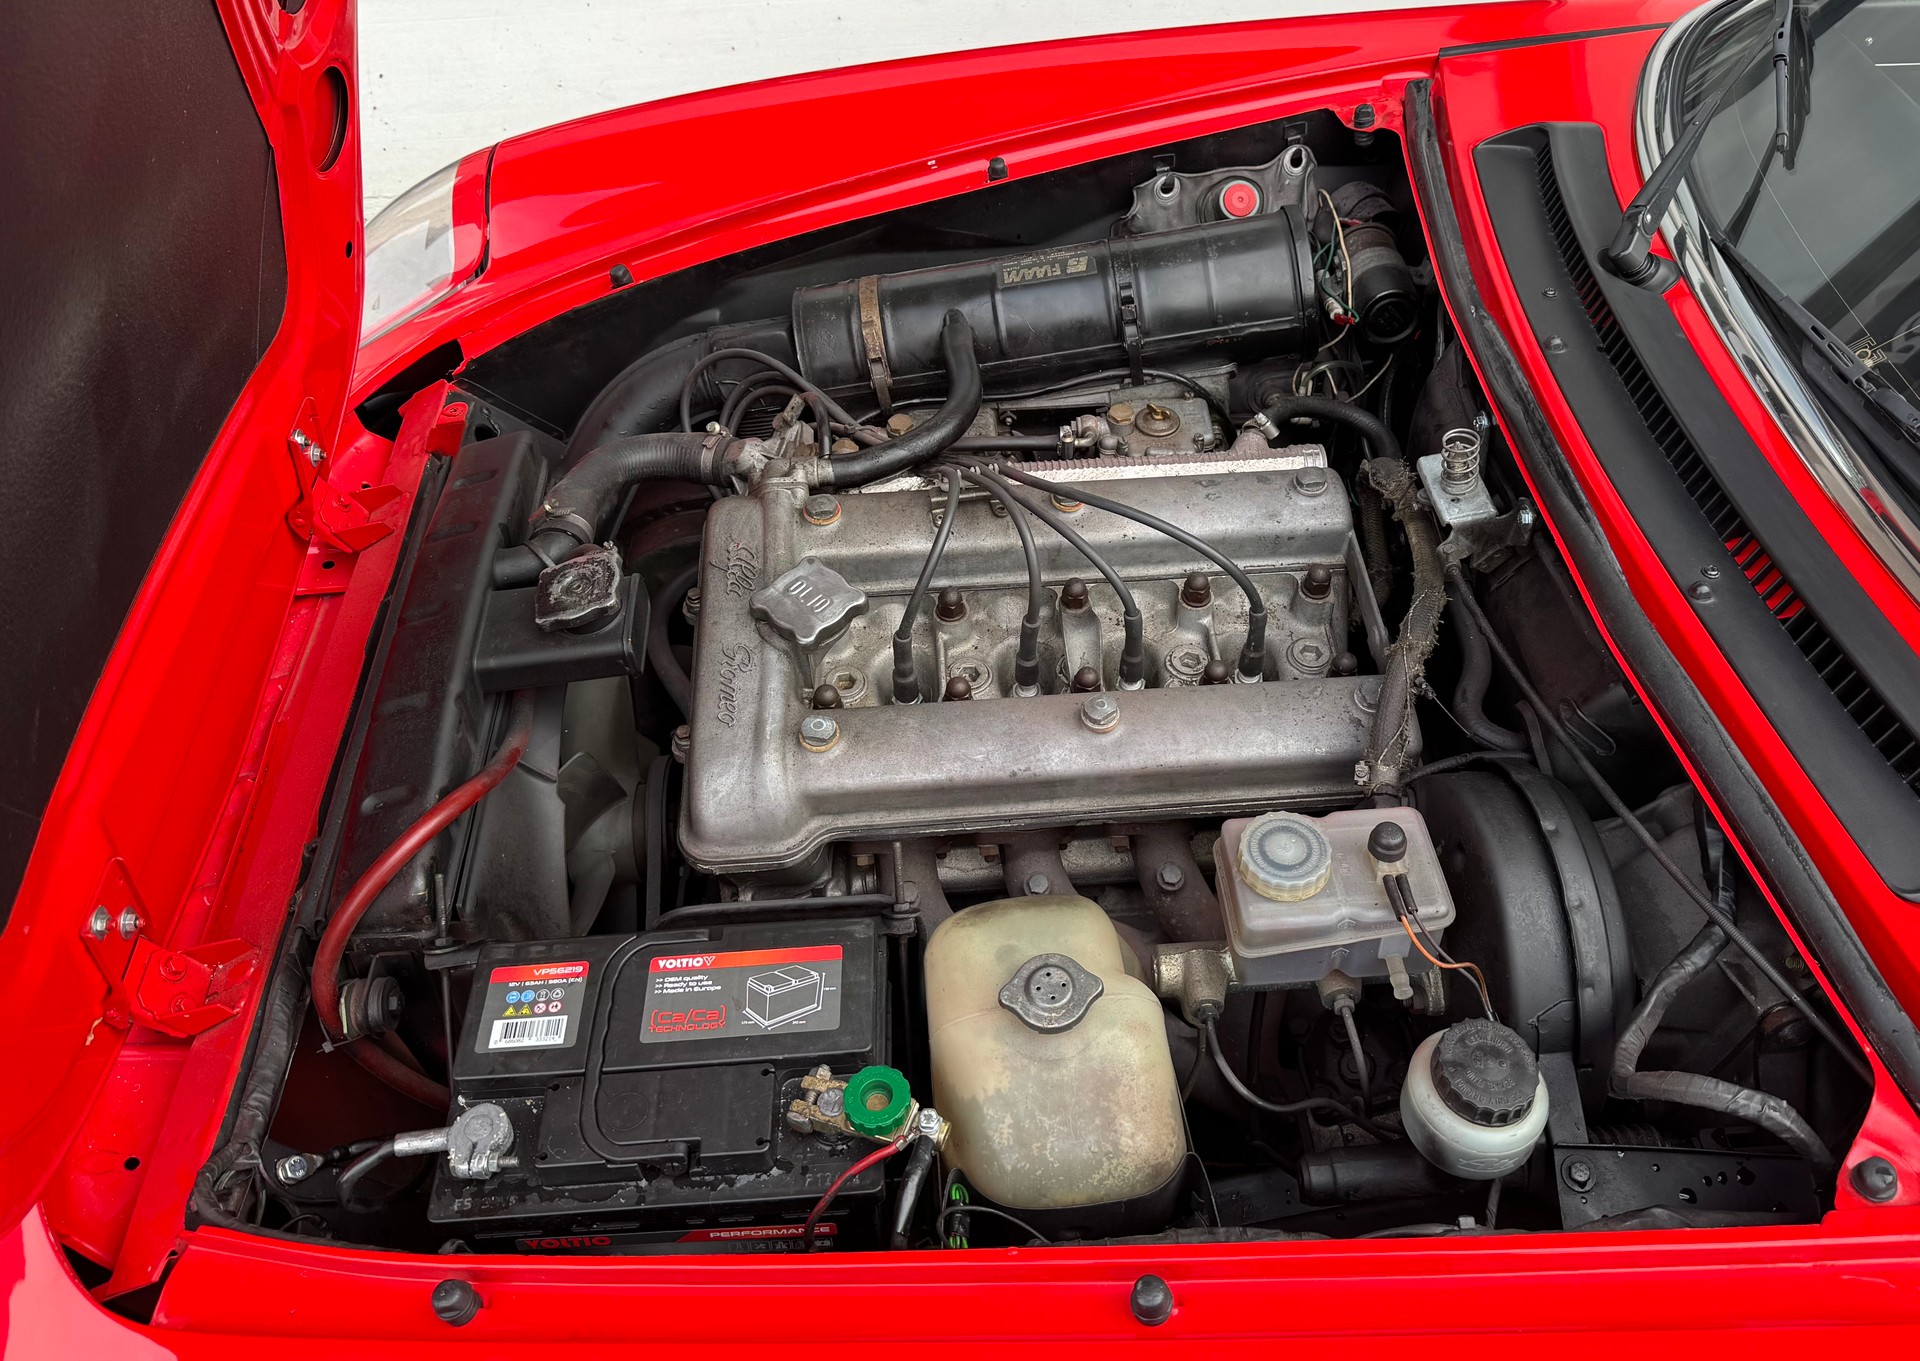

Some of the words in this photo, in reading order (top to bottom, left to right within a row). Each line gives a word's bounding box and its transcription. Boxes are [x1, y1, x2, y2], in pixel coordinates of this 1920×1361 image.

[1003, 264, 1061, 284] FIAAM
[789, 581, 831, 613] OLIO
[534, 966, 583, 976] VP56219
[648, 1021, 726, 1033] TECHNOLOGY
[524, 1236, 612, 1249] VOLTIO
